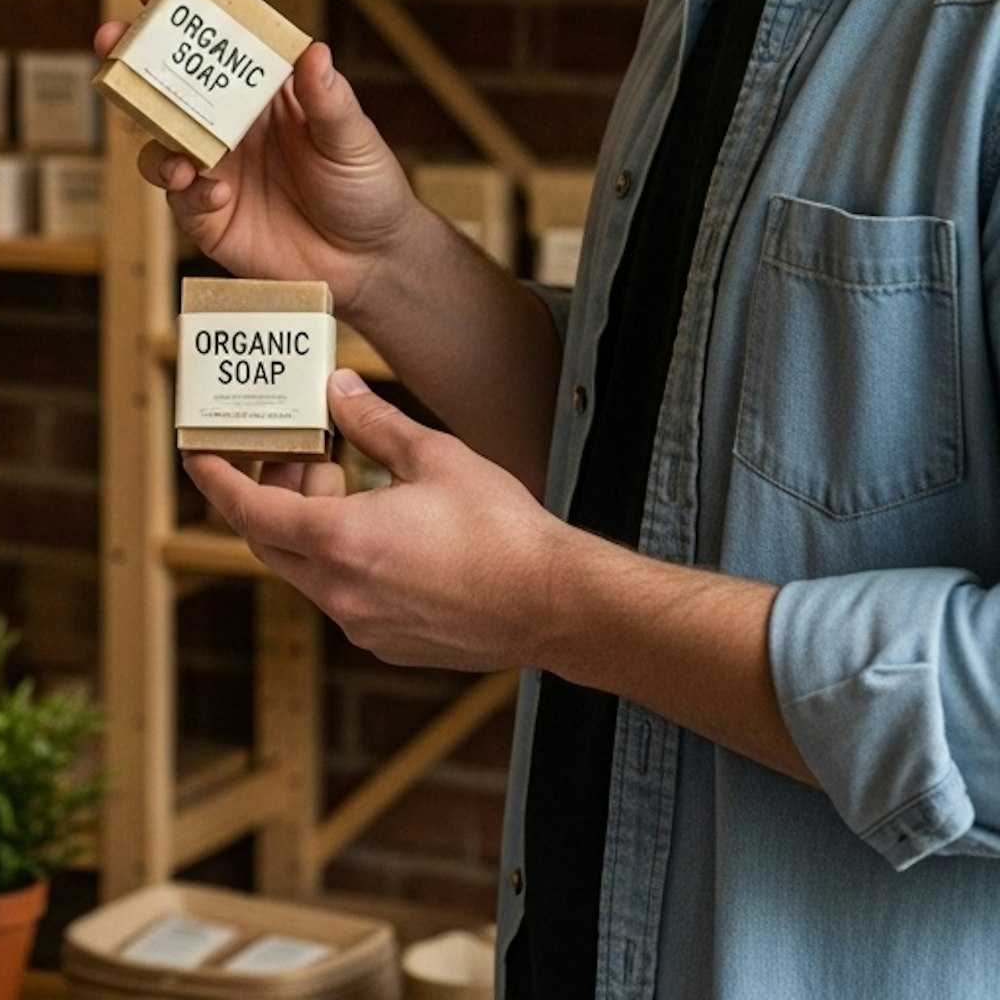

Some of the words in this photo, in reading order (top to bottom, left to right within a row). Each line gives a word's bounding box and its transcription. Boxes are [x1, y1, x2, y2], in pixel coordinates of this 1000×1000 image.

[170, 5, 265, 88] ORGANIC
[171, 42, 230, 92] SOAP
[195, 330, 310, 356] ORGANIC
[218, 359, 286, 385] SOAP
